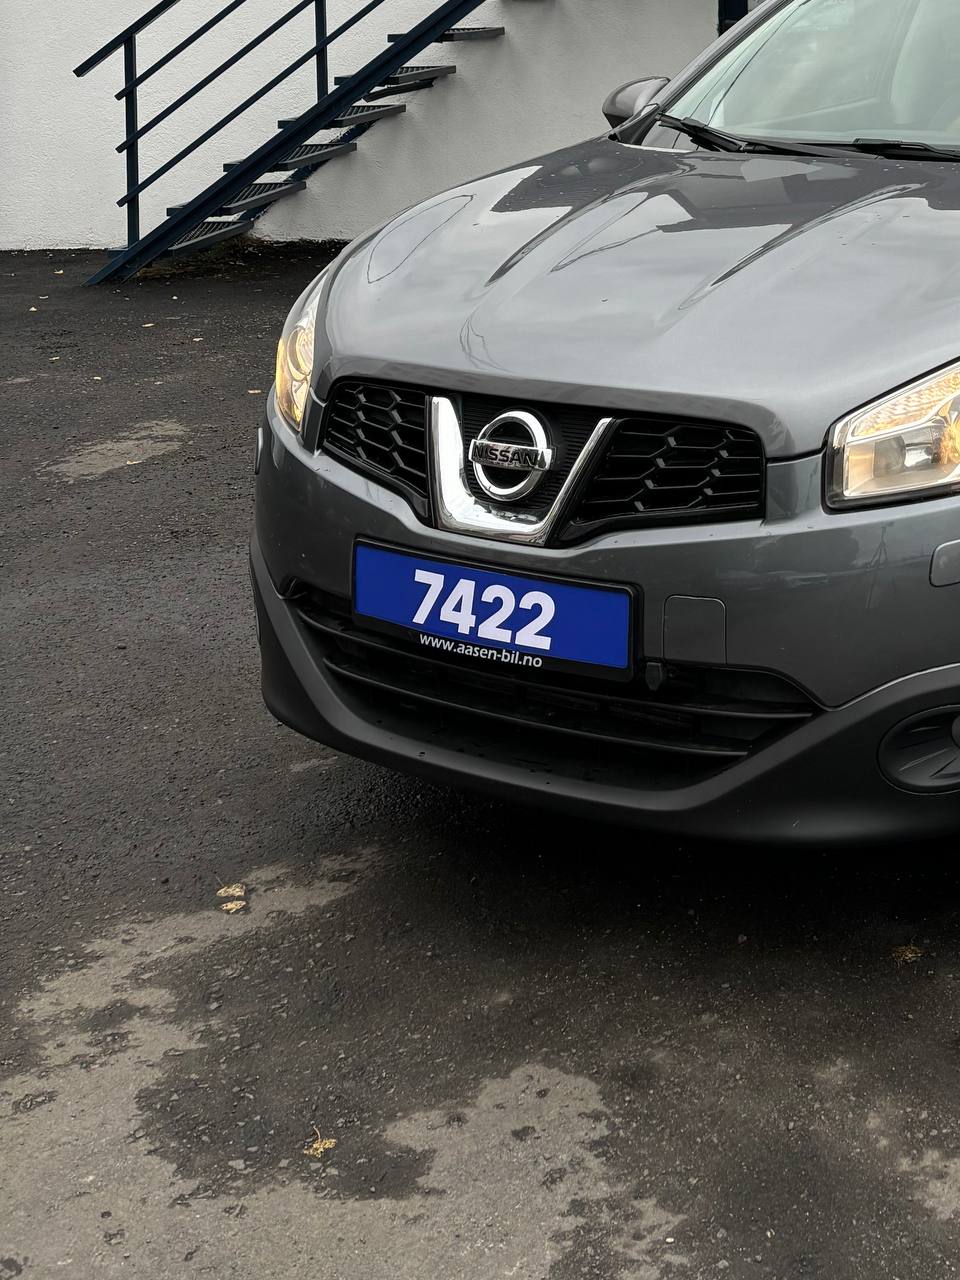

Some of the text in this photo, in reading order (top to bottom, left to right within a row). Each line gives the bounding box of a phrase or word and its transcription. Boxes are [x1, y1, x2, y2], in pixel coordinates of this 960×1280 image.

[472, 443, 539, 468] NISSAN
[412, 569, 556, 651] 7422
[419, 633, 543, 668] www.aasen-bil.no
